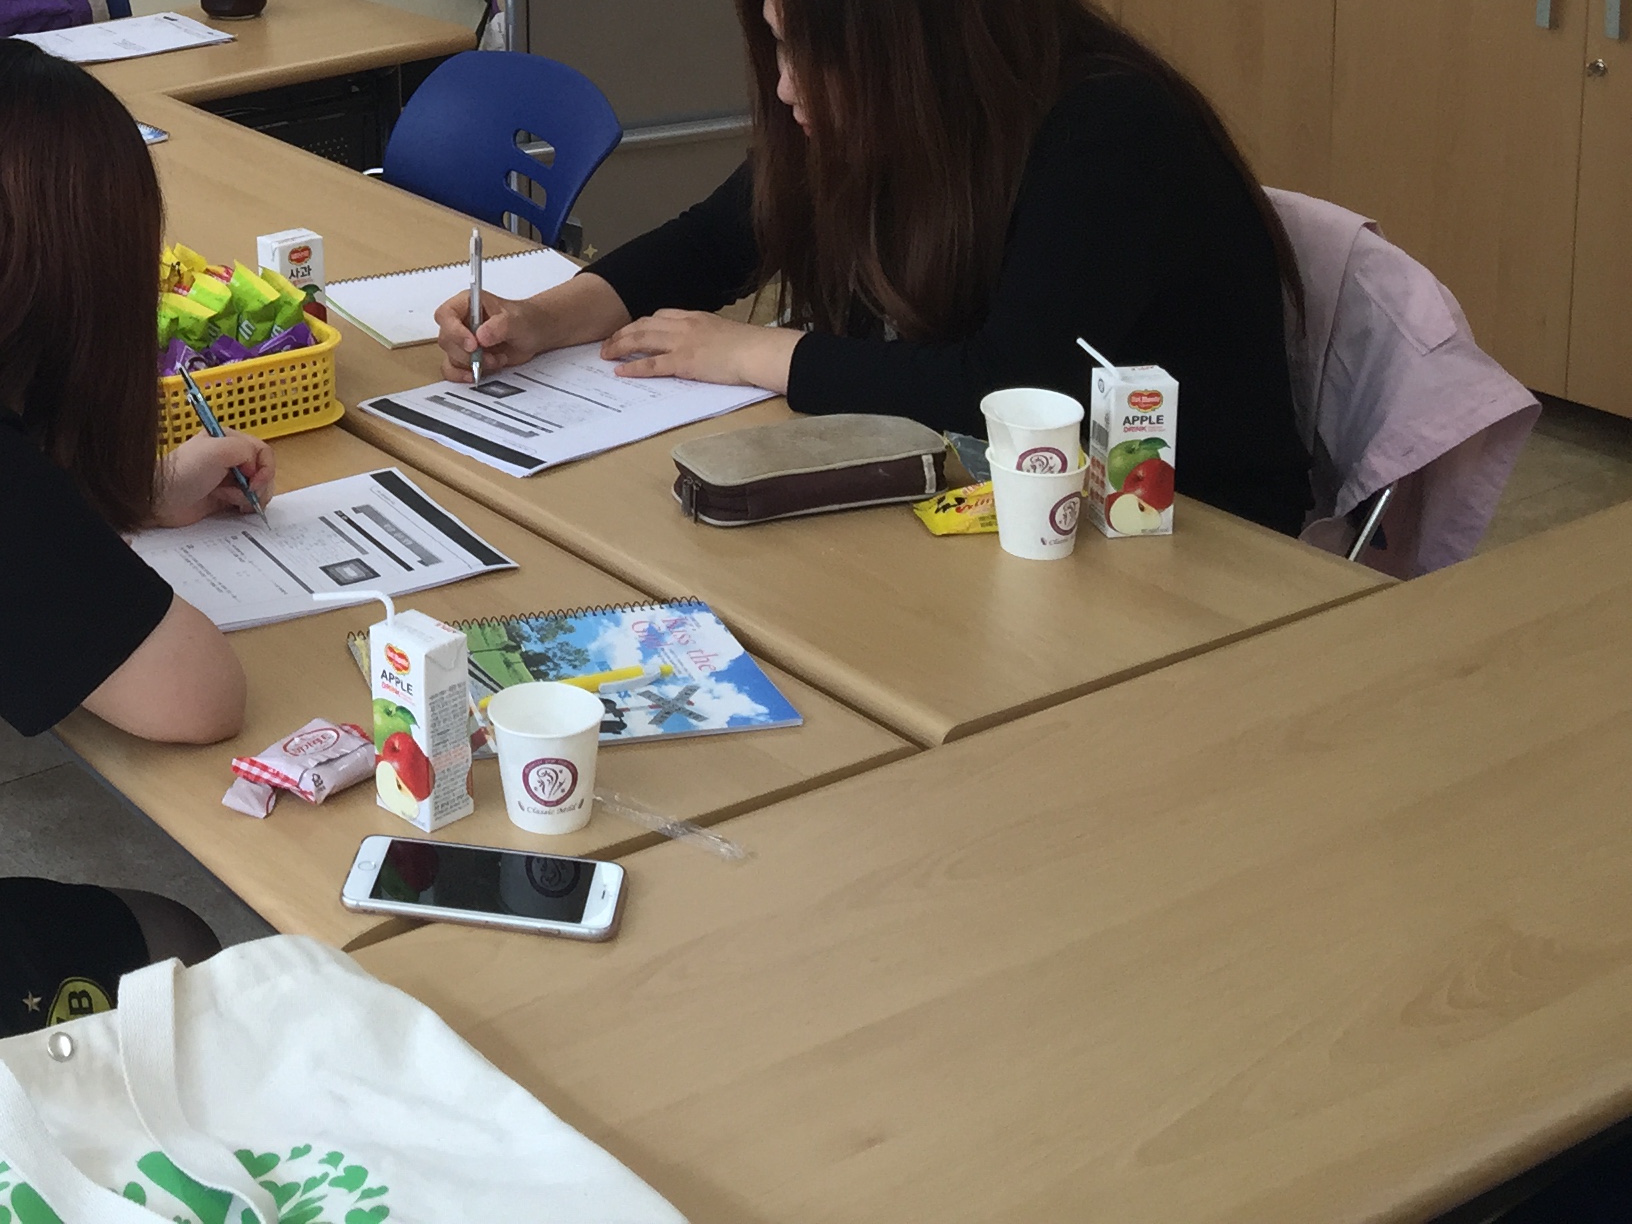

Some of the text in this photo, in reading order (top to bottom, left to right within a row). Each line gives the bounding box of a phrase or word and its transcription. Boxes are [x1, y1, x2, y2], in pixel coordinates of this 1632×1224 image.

[288, 265, 312, 279] 사과
[1123, 415, 1164, 425] APPLE
[661, 617, 695, 647] Kiss
[687, 649, 719, 672] the
[380, 669, 414, 696] APPLE
